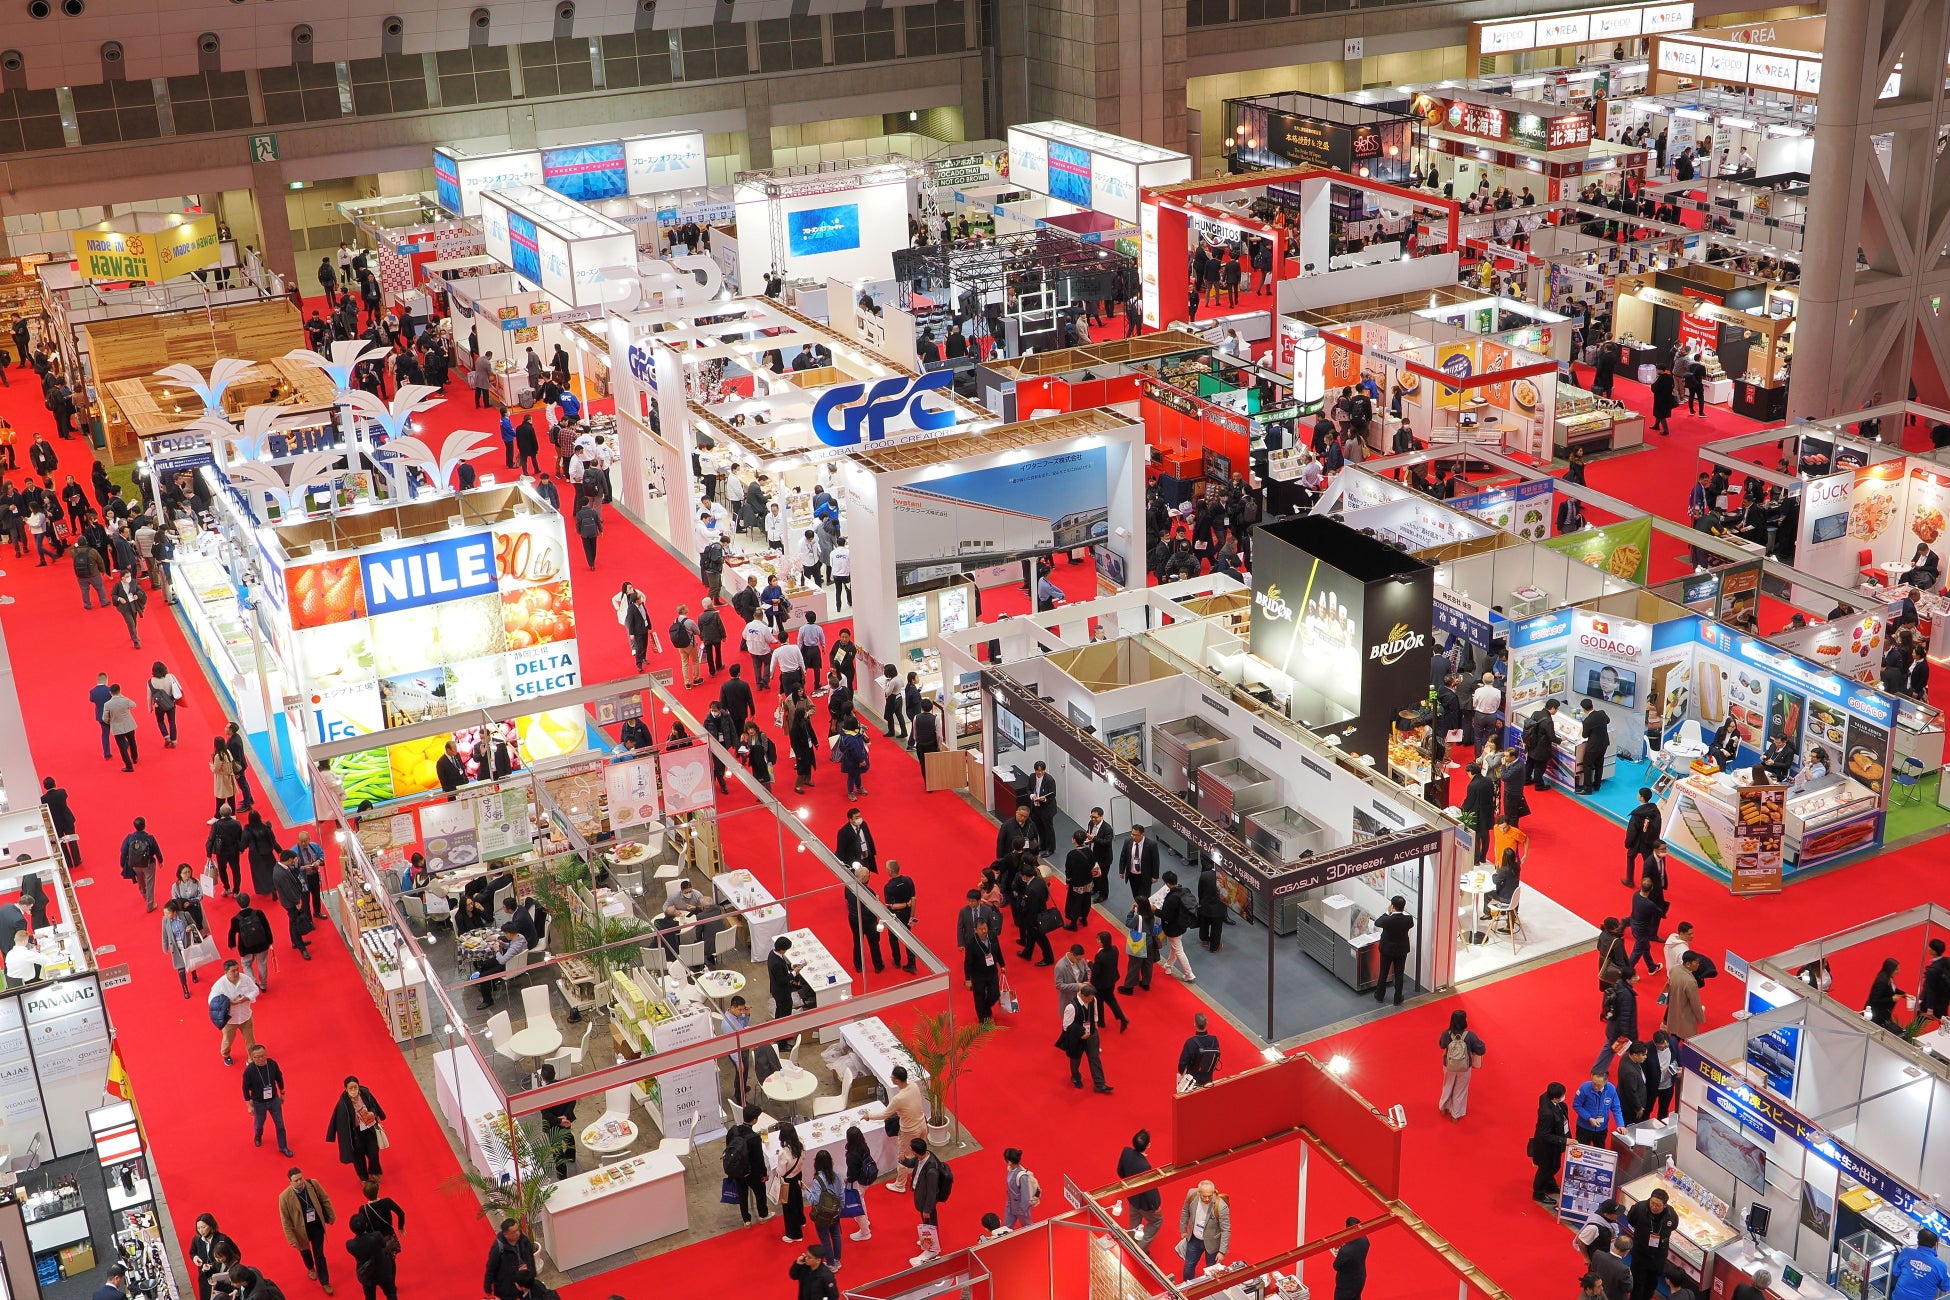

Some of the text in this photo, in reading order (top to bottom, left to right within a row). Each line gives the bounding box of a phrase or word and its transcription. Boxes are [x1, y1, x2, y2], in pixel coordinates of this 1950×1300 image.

[1651, 12, 1682, 25] KOREA
[1545, 23, 1578, 37] KOREA
[1730, 26, 1776, 43] KOREA
[1664, 50, 1696, 65] KOREA
[1755, 63, 1790, 79] KOREA
[1464, 113, 1502, 138] 北海道
[1550, 127, 1588, 147] 北海道
[940, 178, 953, 186] NOT
[966, 174, 989, 182] BROWN
[1193, 217, 1240, 242] HUNGRITOS
[811, 369, 957, 448] GFC
[814, 446, 859, 460] GLOBAL
[864, 438, 895, 450] FOOD
[892, 497, 922, 508] Iwatani
[1811, 482, 1849, 503] DUCK
[369, 543, 490, 604] NILE
[1255, 590, 1293, 623] BRIDOR
[1530, 625, 1564, 640] GODACO
[1369, 630, 1425, 660] BRIDOR
[1580, 633, 1636, 656] GODACO
[515, 653, 573, 676] DELTA
[515, 672, 577, 697] SELECT
[1848, 697, 1886, 720] GODACO
[1675, 783, 1697, 799] GODACO
[1272, 875, 1320, 897] KOGASUN
[27, 986, 95, 1014] PANAVAC
[0, 1066, 29, 1079] LAJAS
[674, 1085, 693, 1096] 30+
[676, 1099, 701, 1112] 5000+
[678, 1114, 707, 1128] 1000+
